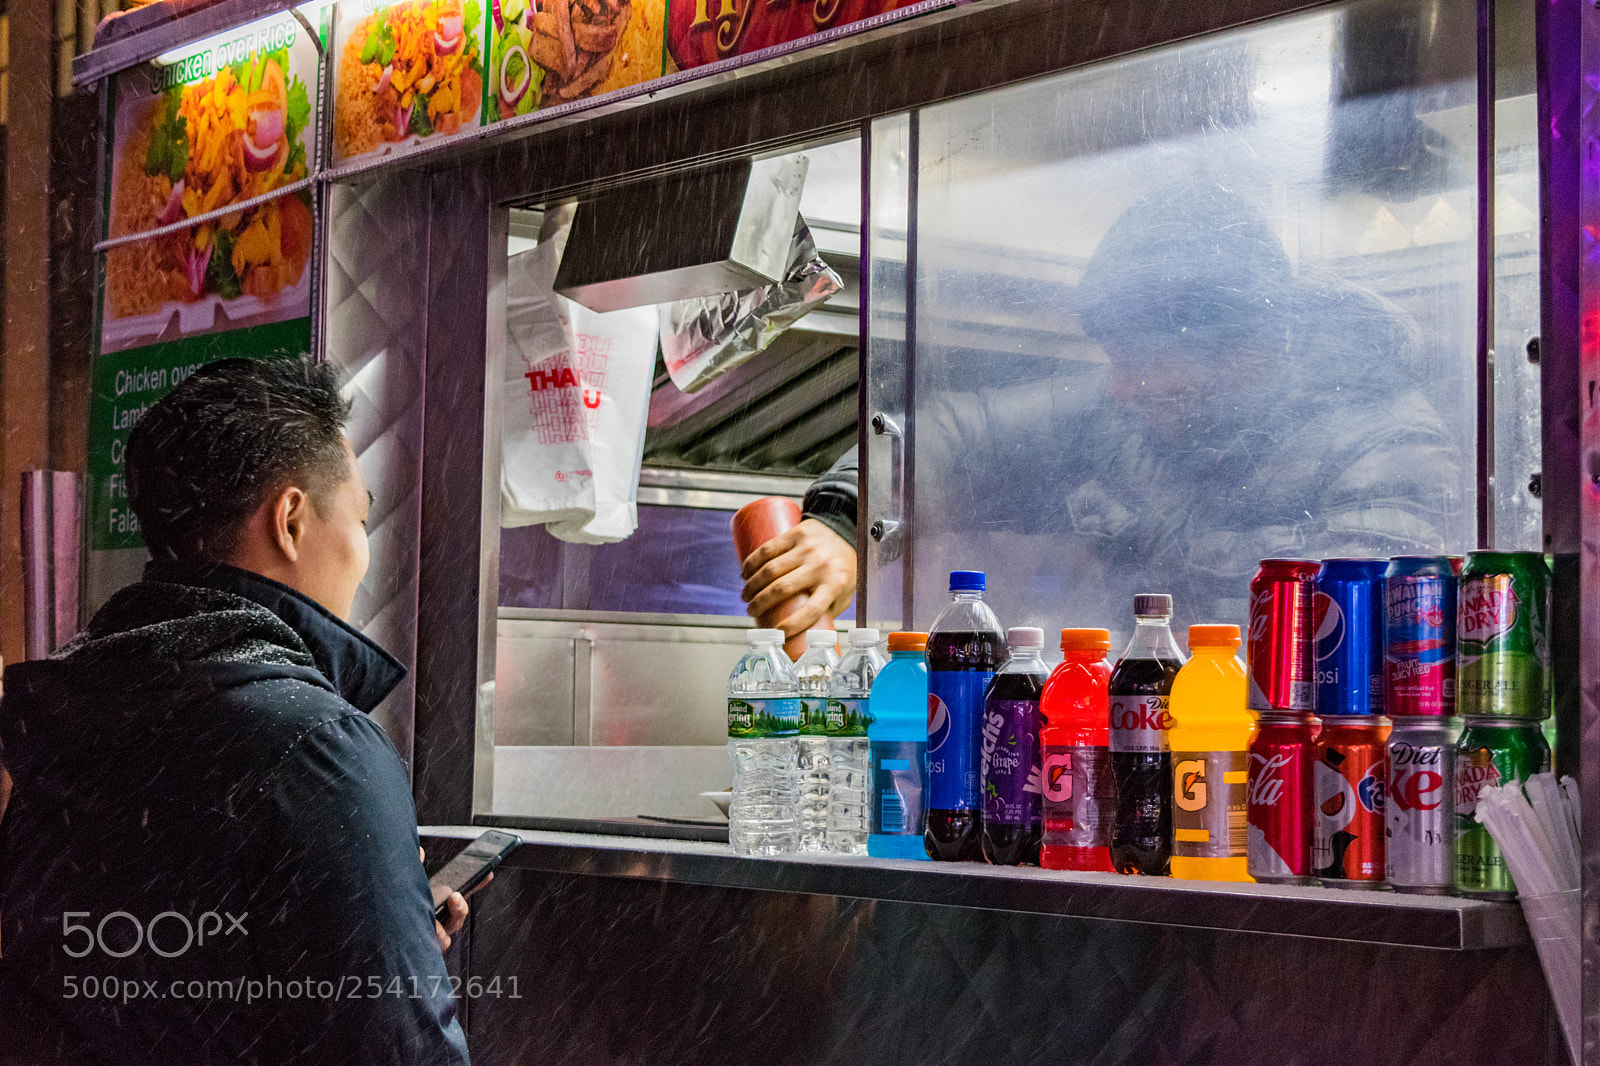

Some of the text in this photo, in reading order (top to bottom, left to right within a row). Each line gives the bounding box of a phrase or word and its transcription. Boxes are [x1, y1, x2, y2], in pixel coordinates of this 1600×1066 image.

[217, 35, 252, 71] over
[115, 366, 167, 395] Chicken
[525, 368, 580, 391] THA
[109, 508, 138, 533] Fala
[1459, 587, 1521, 617] ANADA
[1464, 609, 1500, 633] DRY
[1396, 658, 1419, 670] FRUIT
[1412, 664, 1431, 676] RED
[1147, 697, 1170, 710] Die
[1111, 703, 1177, 731] Coke
[993, 752, 1020, 775] Grape
[1391, 742, 1442, 766] Diet
[1042, 753, 1073, 803] G
[1174, 759, 1208, 812] G
[1390, 769, 1443, 811] ke
